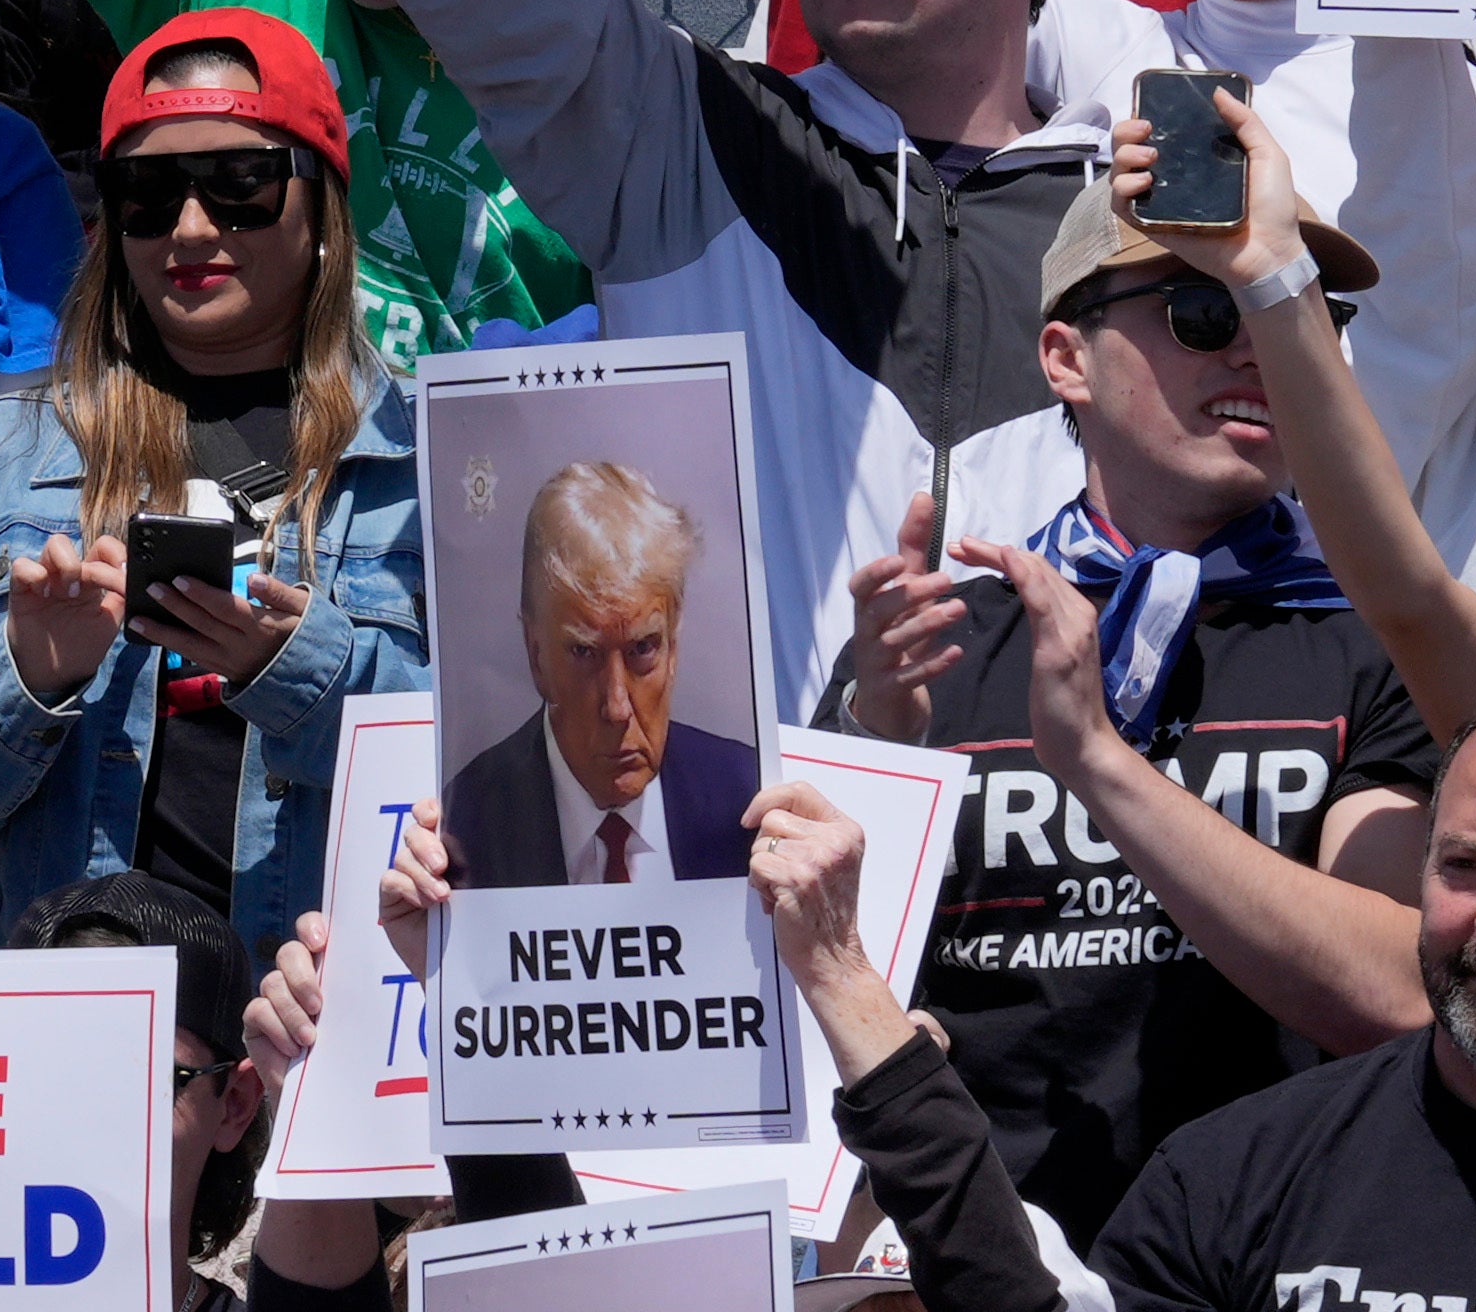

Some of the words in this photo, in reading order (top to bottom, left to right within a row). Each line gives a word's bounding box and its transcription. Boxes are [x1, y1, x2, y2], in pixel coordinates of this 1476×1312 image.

[508, 924, 685, 983] NEVER
[1008, 925, 1210, 970] AMERICA
[453, 994, 769, 1060] SURRENDER
